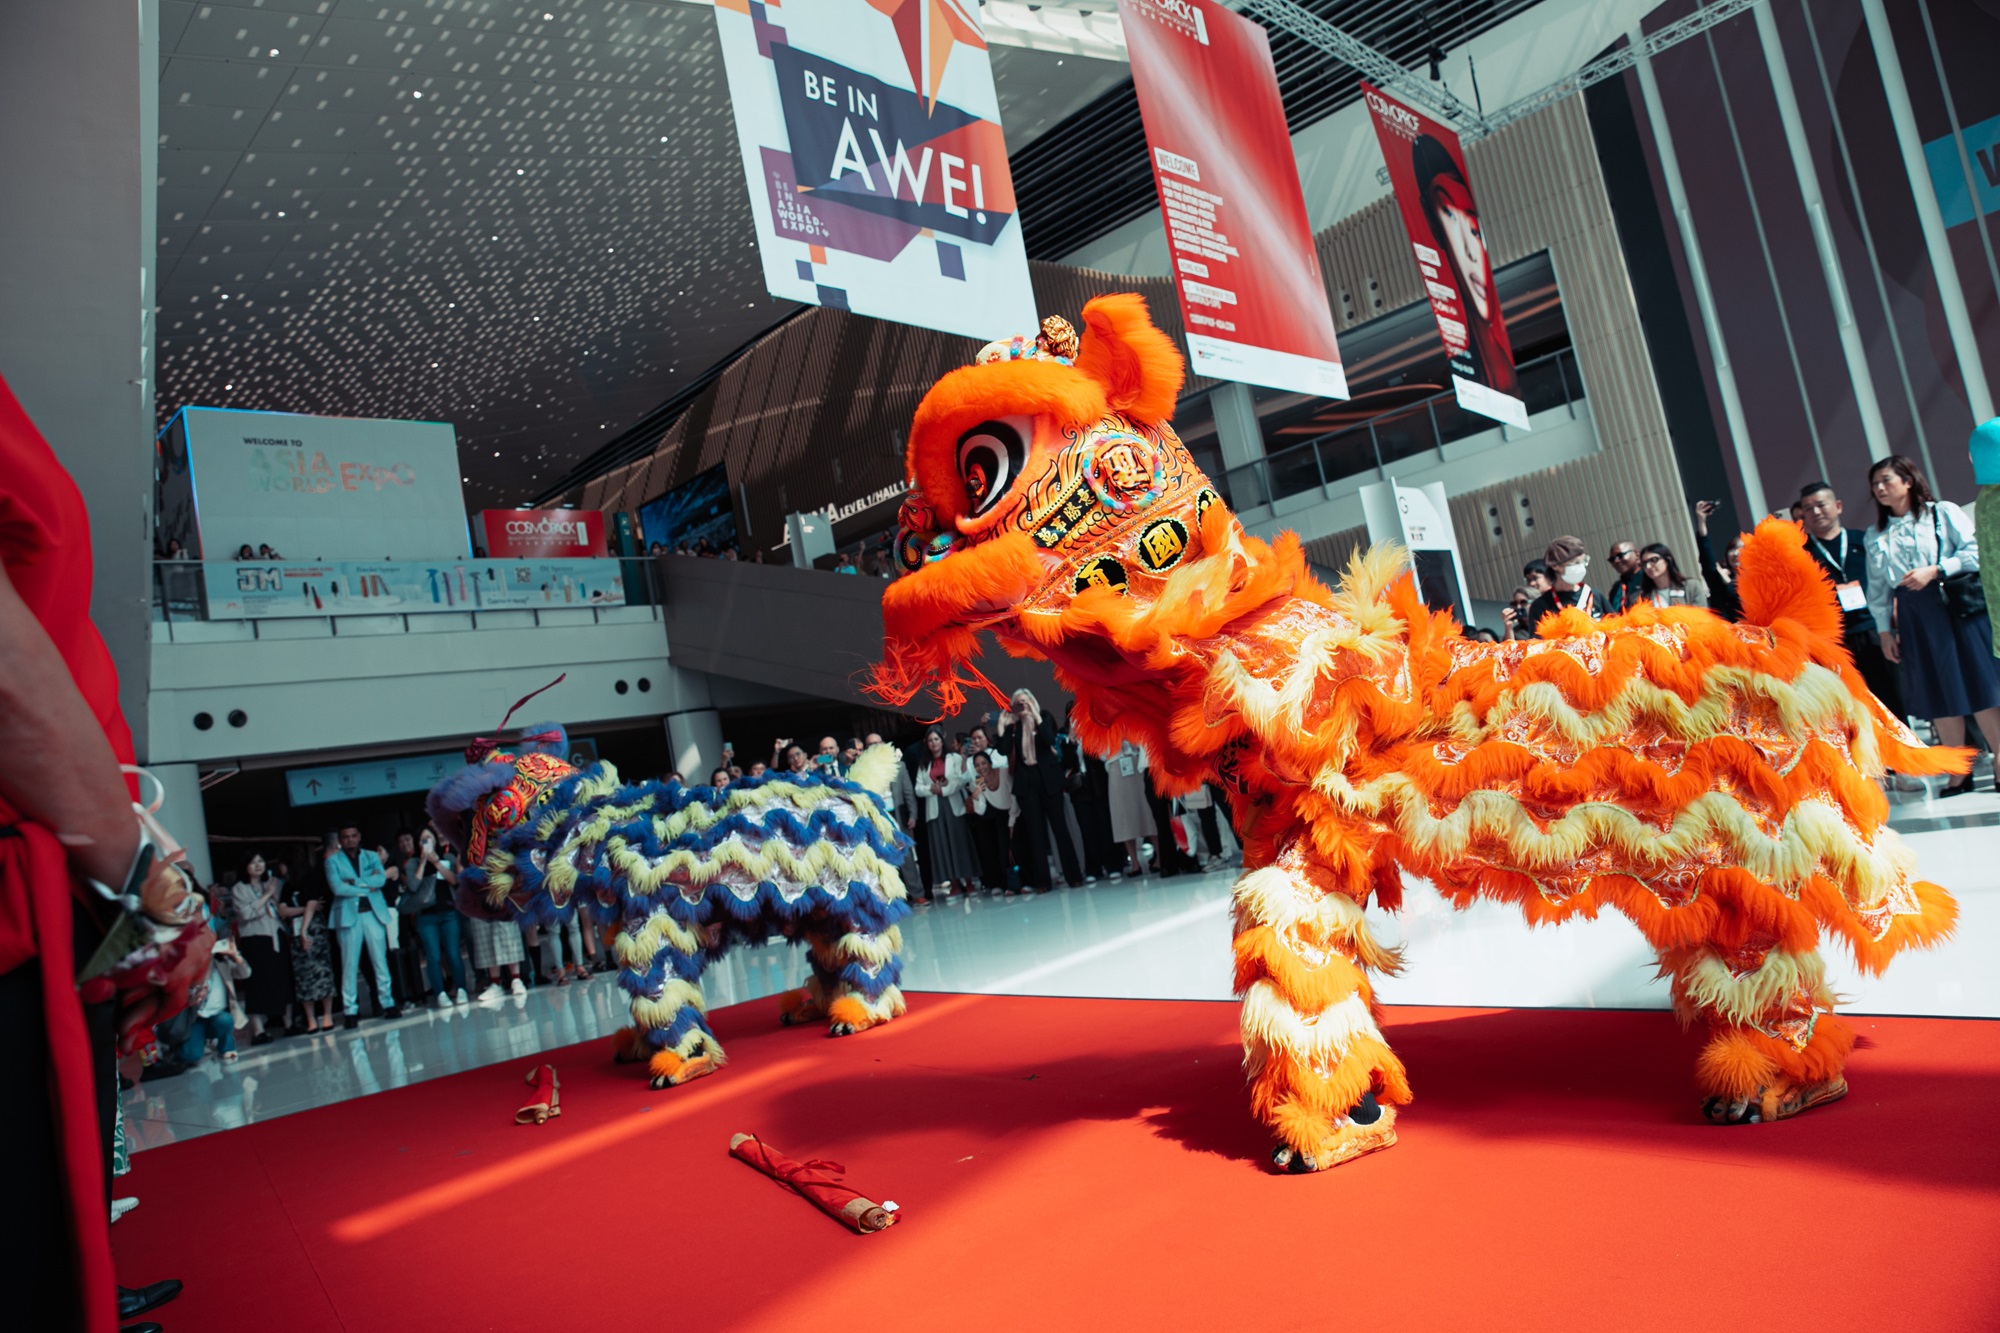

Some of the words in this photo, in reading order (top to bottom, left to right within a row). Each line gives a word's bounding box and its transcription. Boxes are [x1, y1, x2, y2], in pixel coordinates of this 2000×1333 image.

[803, 70, 837, 107] BE
[848, 85, 878, 122] IN
[830, 116, 987, 225] AWE!
[1157, 153, 1197, 178] WELCOME
[777, 190, 793, 202] IN
[778, 199, 811, 215] ASIA
[243, 437, 288, 446] WELCOME
[291, 439, 303, 447] TO
[251, 449, 335, 477] ASIA
[840, 498, 865, 518] LEVEL
[1036, 488, 1096, 547] 萬事勝意
[1142, 521, 1182, 568] 國
[236, 567, 283, 592] JM
[571, 753, 585, 767] G
